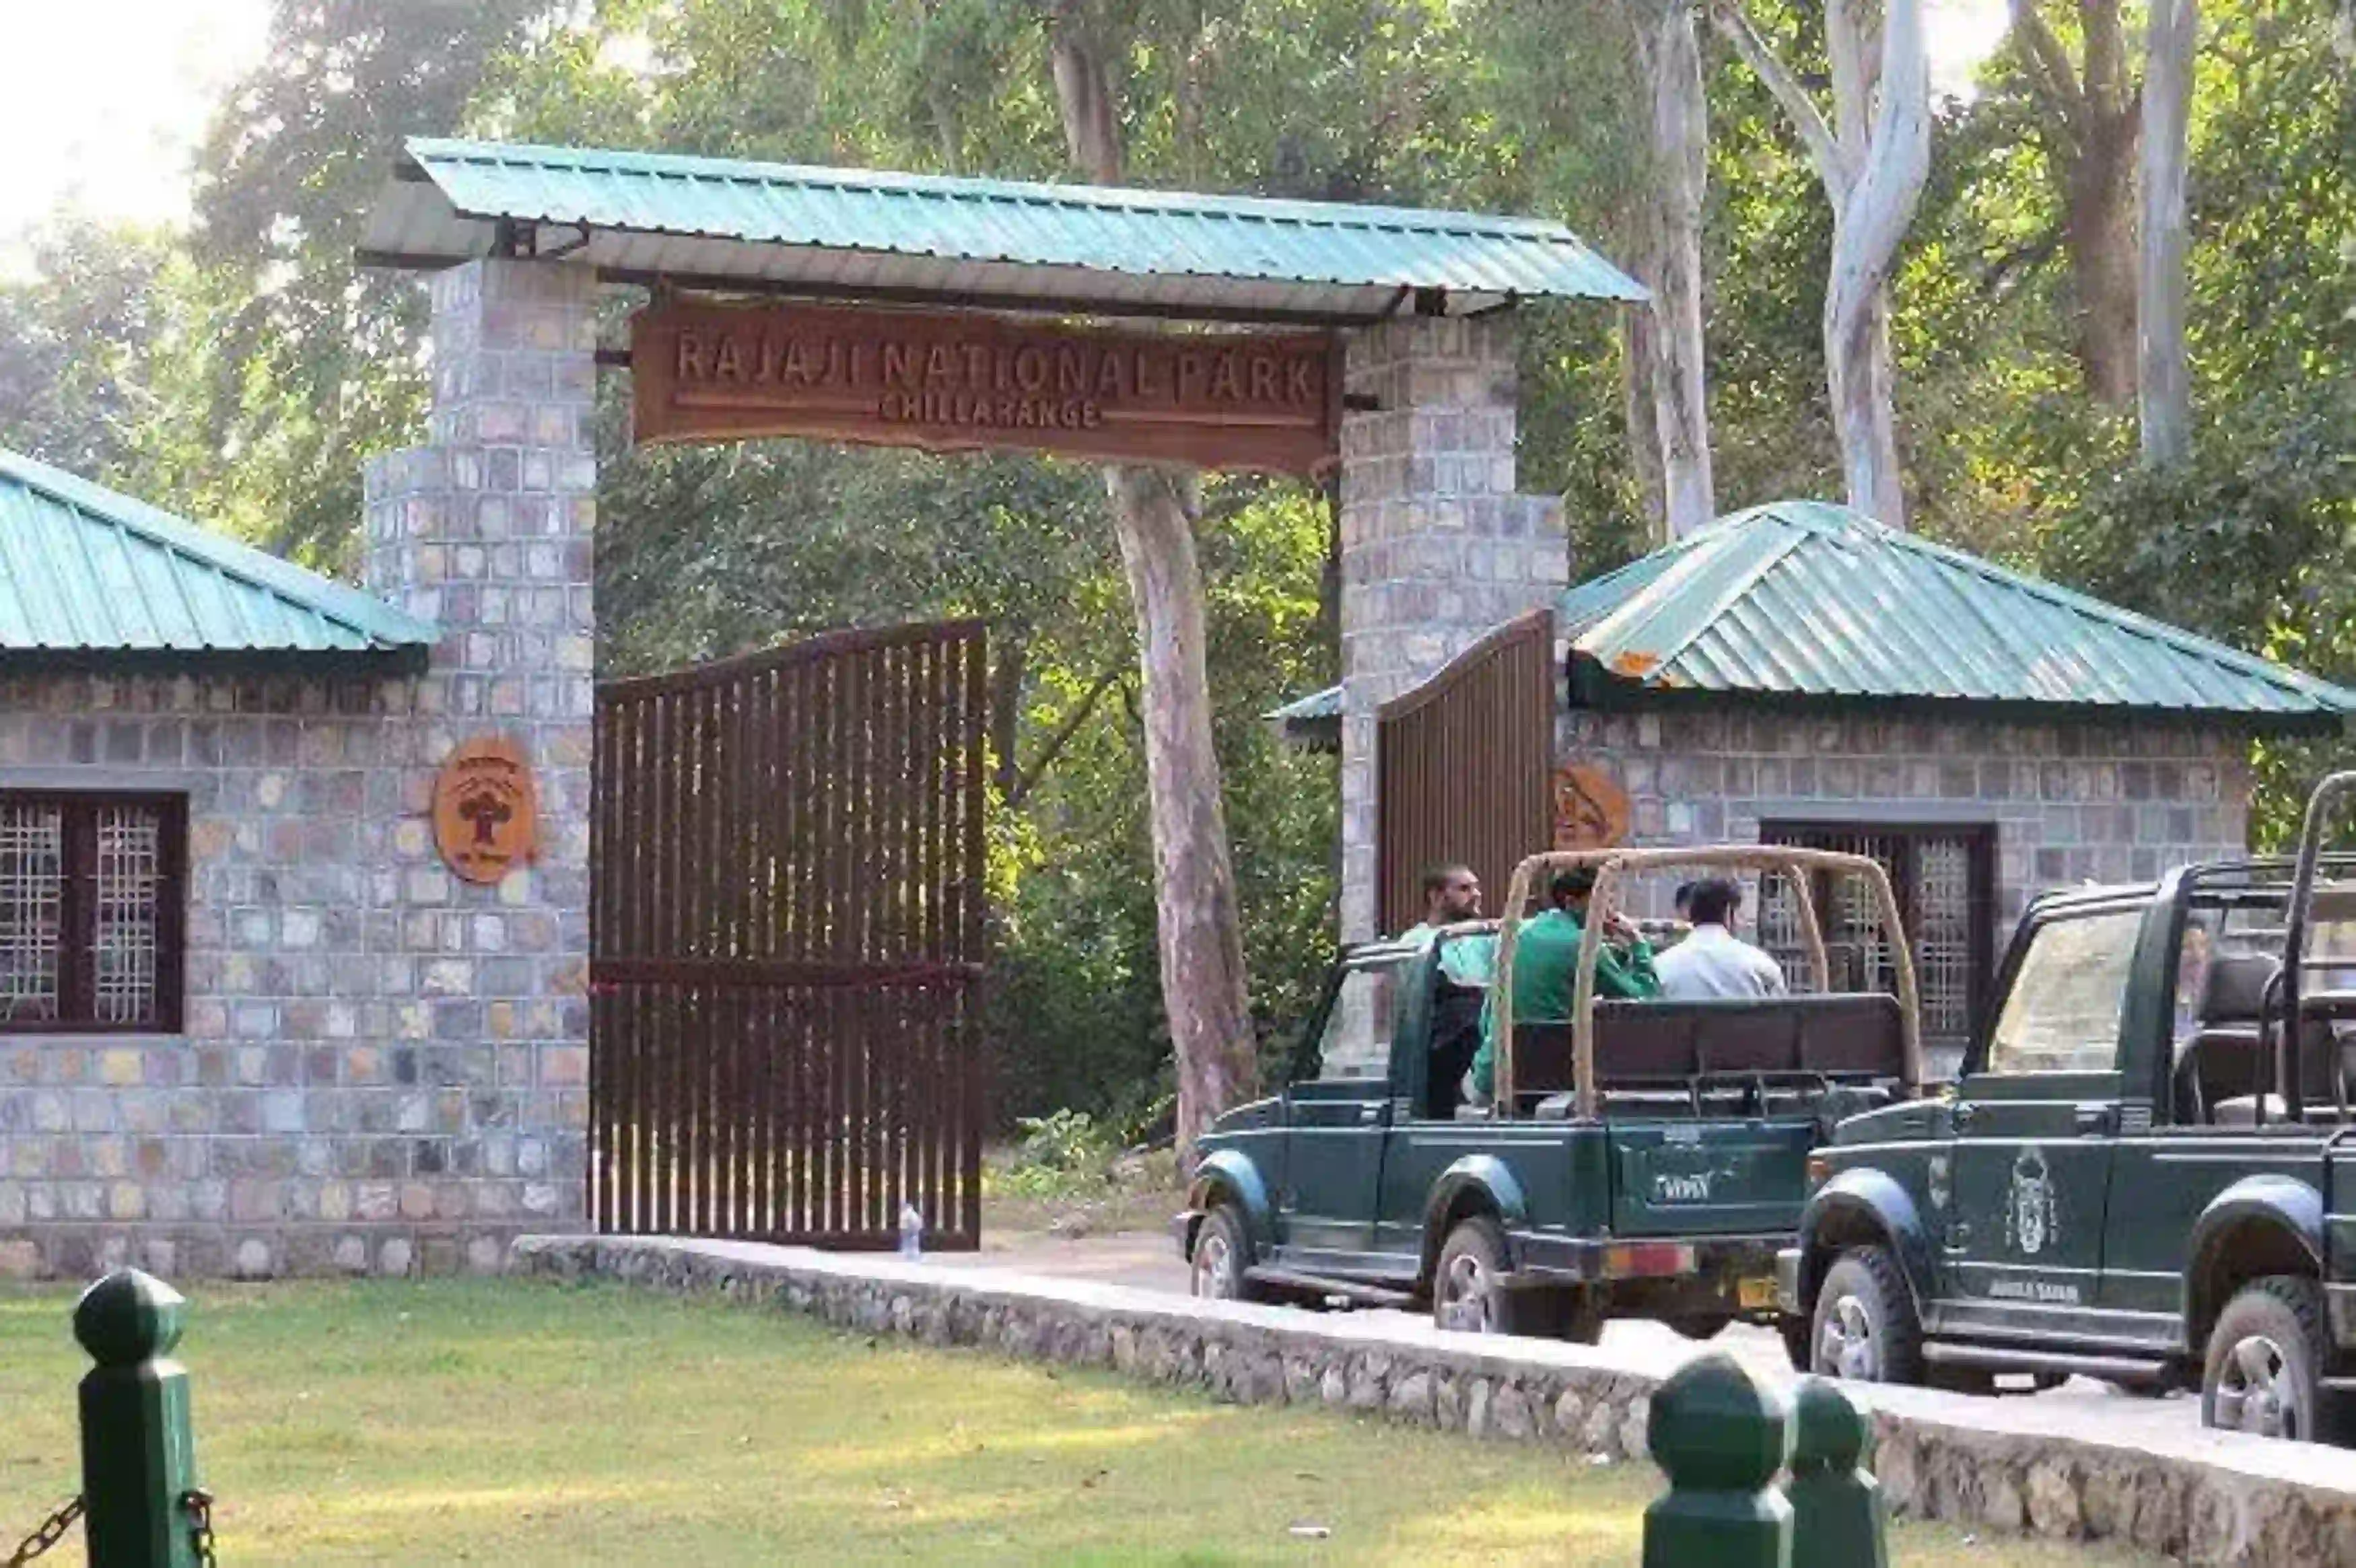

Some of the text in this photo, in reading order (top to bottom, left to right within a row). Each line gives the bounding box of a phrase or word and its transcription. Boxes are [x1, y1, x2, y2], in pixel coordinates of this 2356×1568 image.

[677, 331, 1311, 402] RAJAJI NATIONAL PARK
